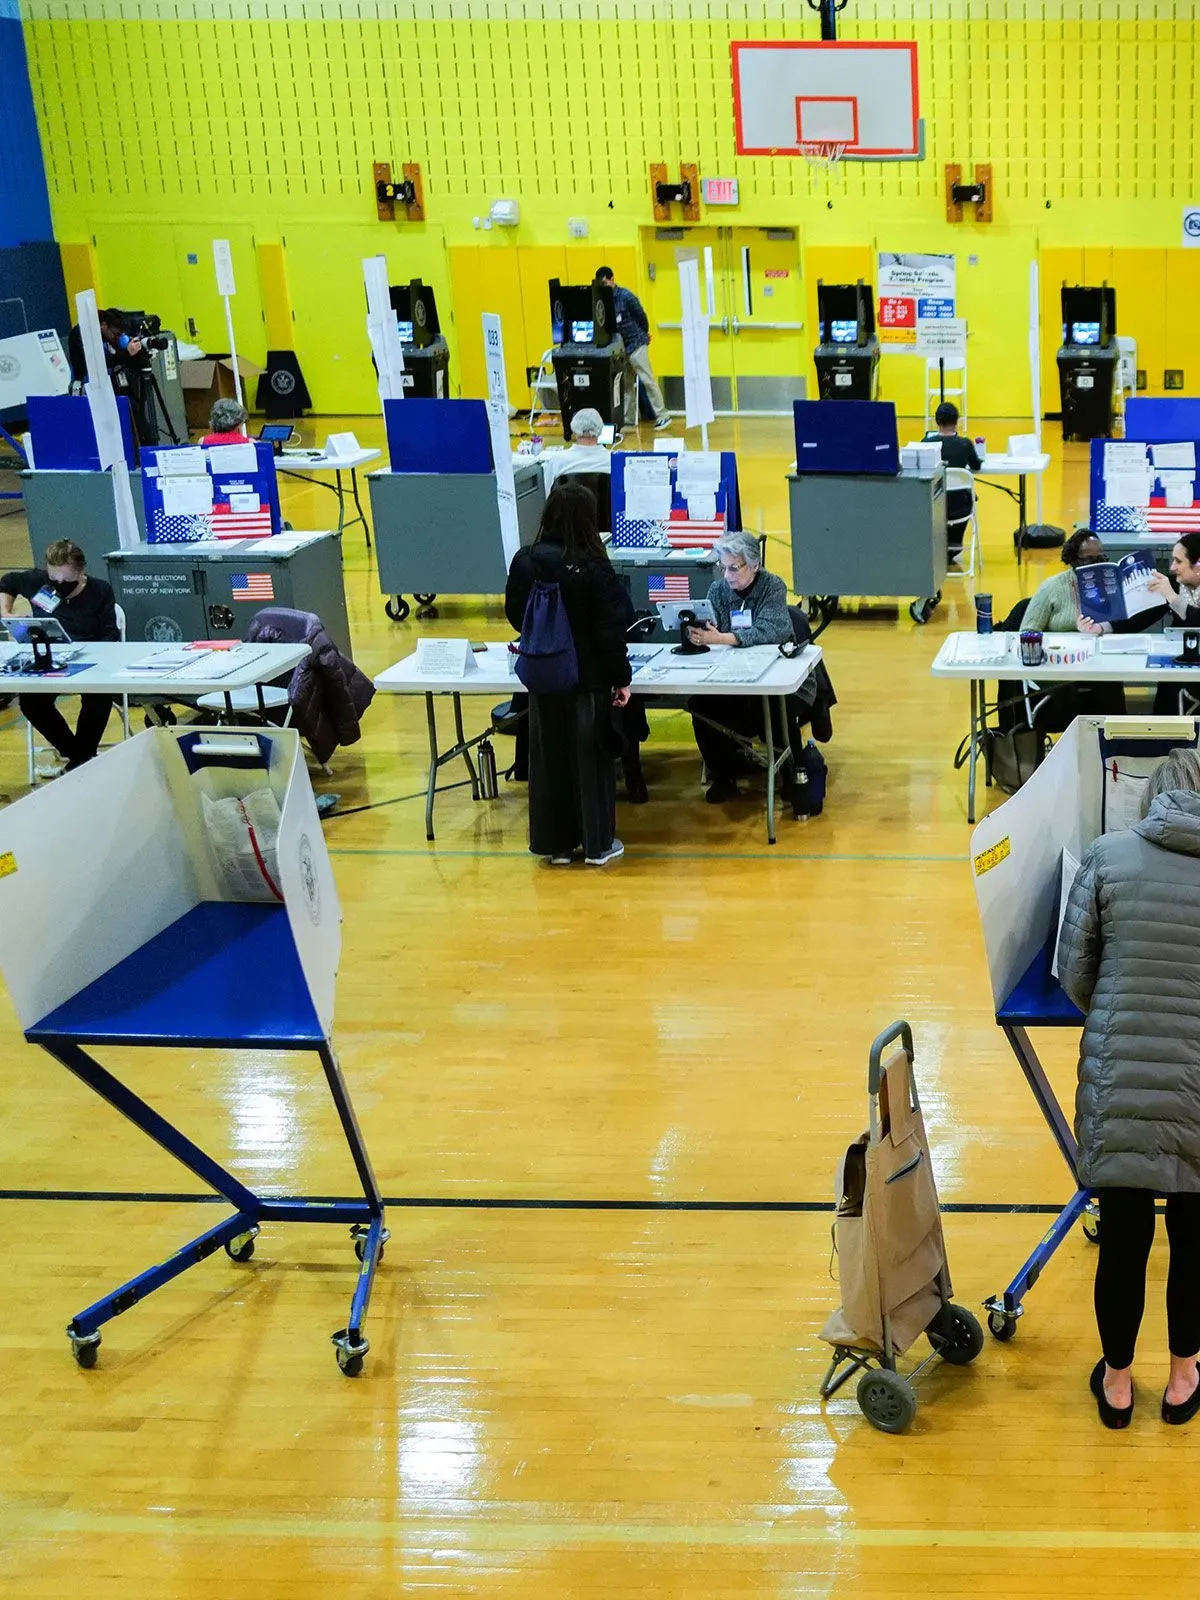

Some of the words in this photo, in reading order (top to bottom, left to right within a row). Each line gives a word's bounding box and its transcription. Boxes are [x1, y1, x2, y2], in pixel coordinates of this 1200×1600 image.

[386, 185, 394, 196] 2
[707, 180, 733, 201] EXIT
[488, 329, 498, 346] 033
